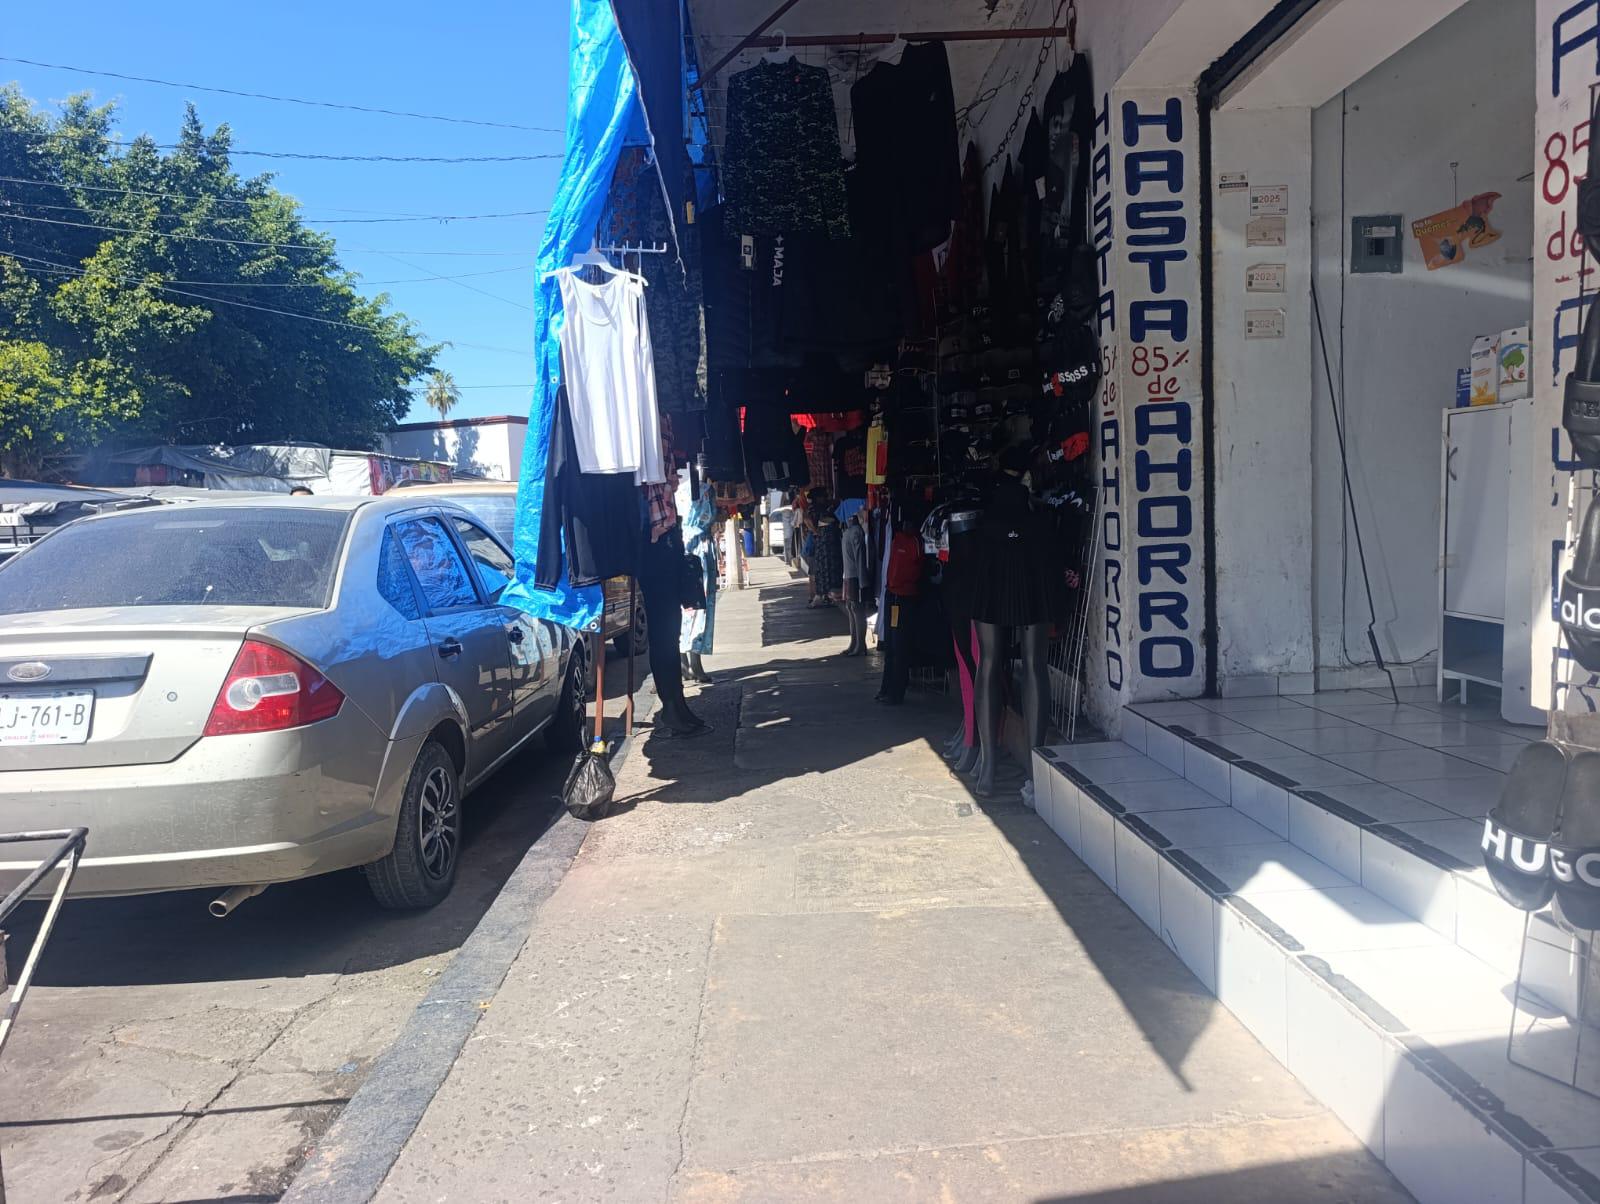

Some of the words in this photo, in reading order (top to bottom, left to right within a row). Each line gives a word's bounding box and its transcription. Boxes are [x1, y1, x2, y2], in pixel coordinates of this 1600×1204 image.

[1091, 92, 1116, 339] HASTA
[1122, 97, 1189, 343] HASTA
[1259, 194, 1281, 204] 2025
[1102, 379, 1117, 407] de
[1131, 346, 1190, 377] 85%
[1147, 374, 1181, 395] de
[1101, 418, 1124, 691] AHORRO
[1134, 402, 1195, 679] AHORRO
